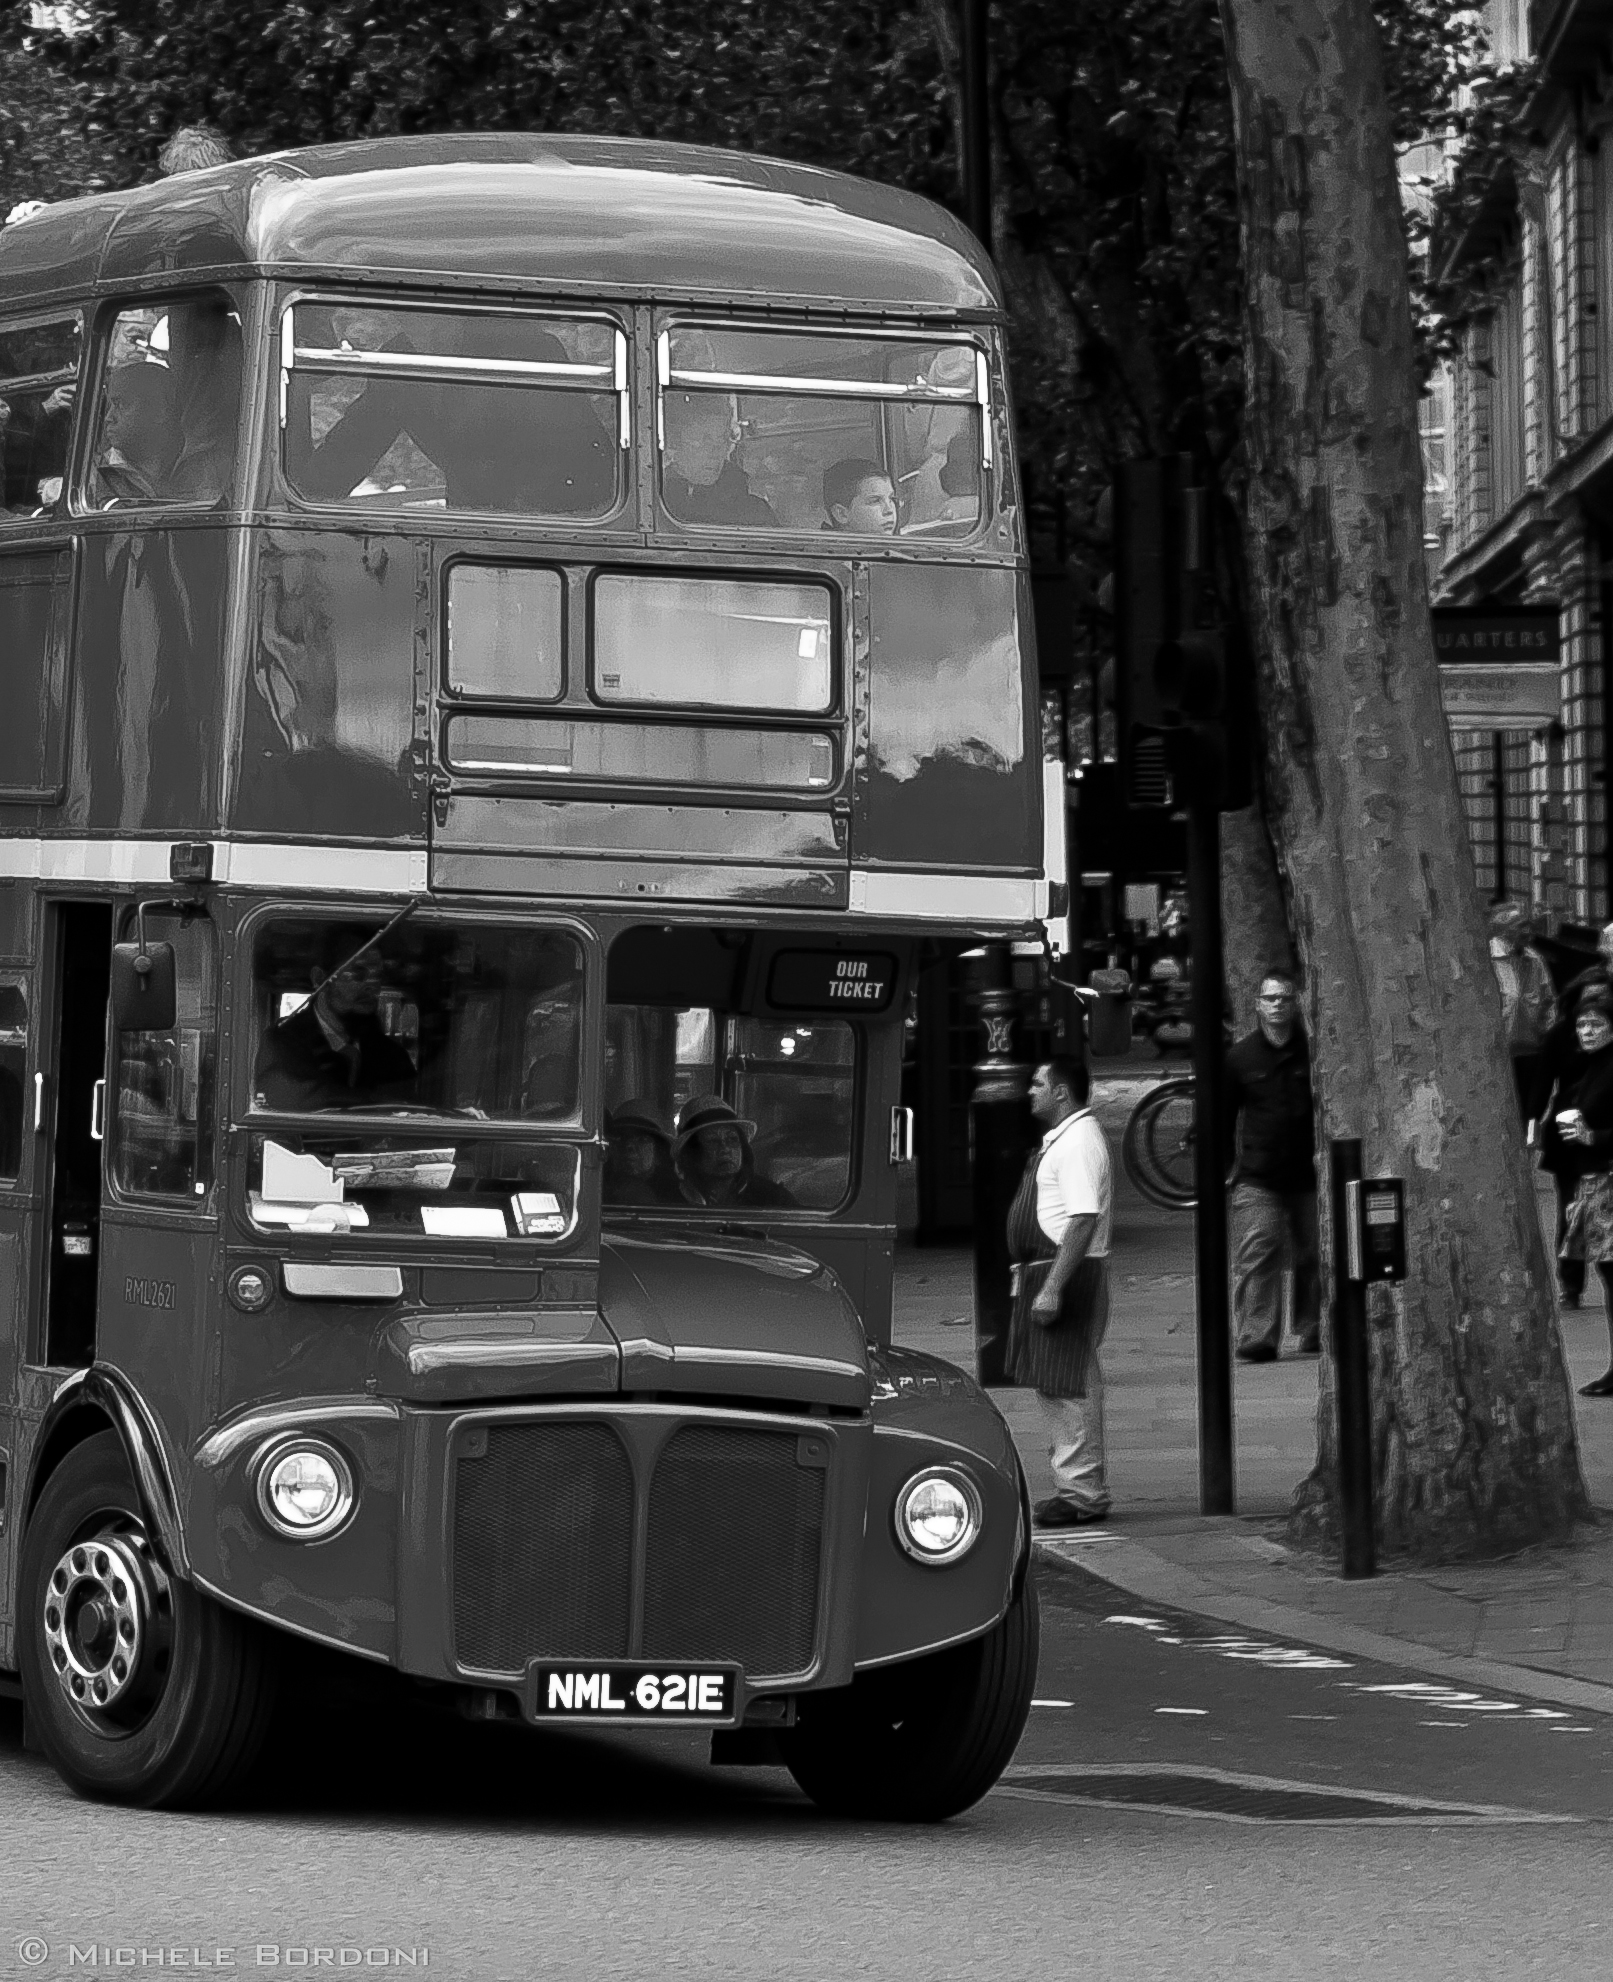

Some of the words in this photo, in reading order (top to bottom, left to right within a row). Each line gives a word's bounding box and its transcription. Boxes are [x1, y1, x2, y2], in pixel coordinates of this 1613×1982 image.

[1436, 630, 1548, 648] UARTERS
[836, 960, 868, 978] OUR
[828, 980, 884, 998] TICKET
[125, 1276, 176, 1309] RML2621
[548, 1673, 626, 1709] NML
[635, 1674, 724, 1710] 621E
